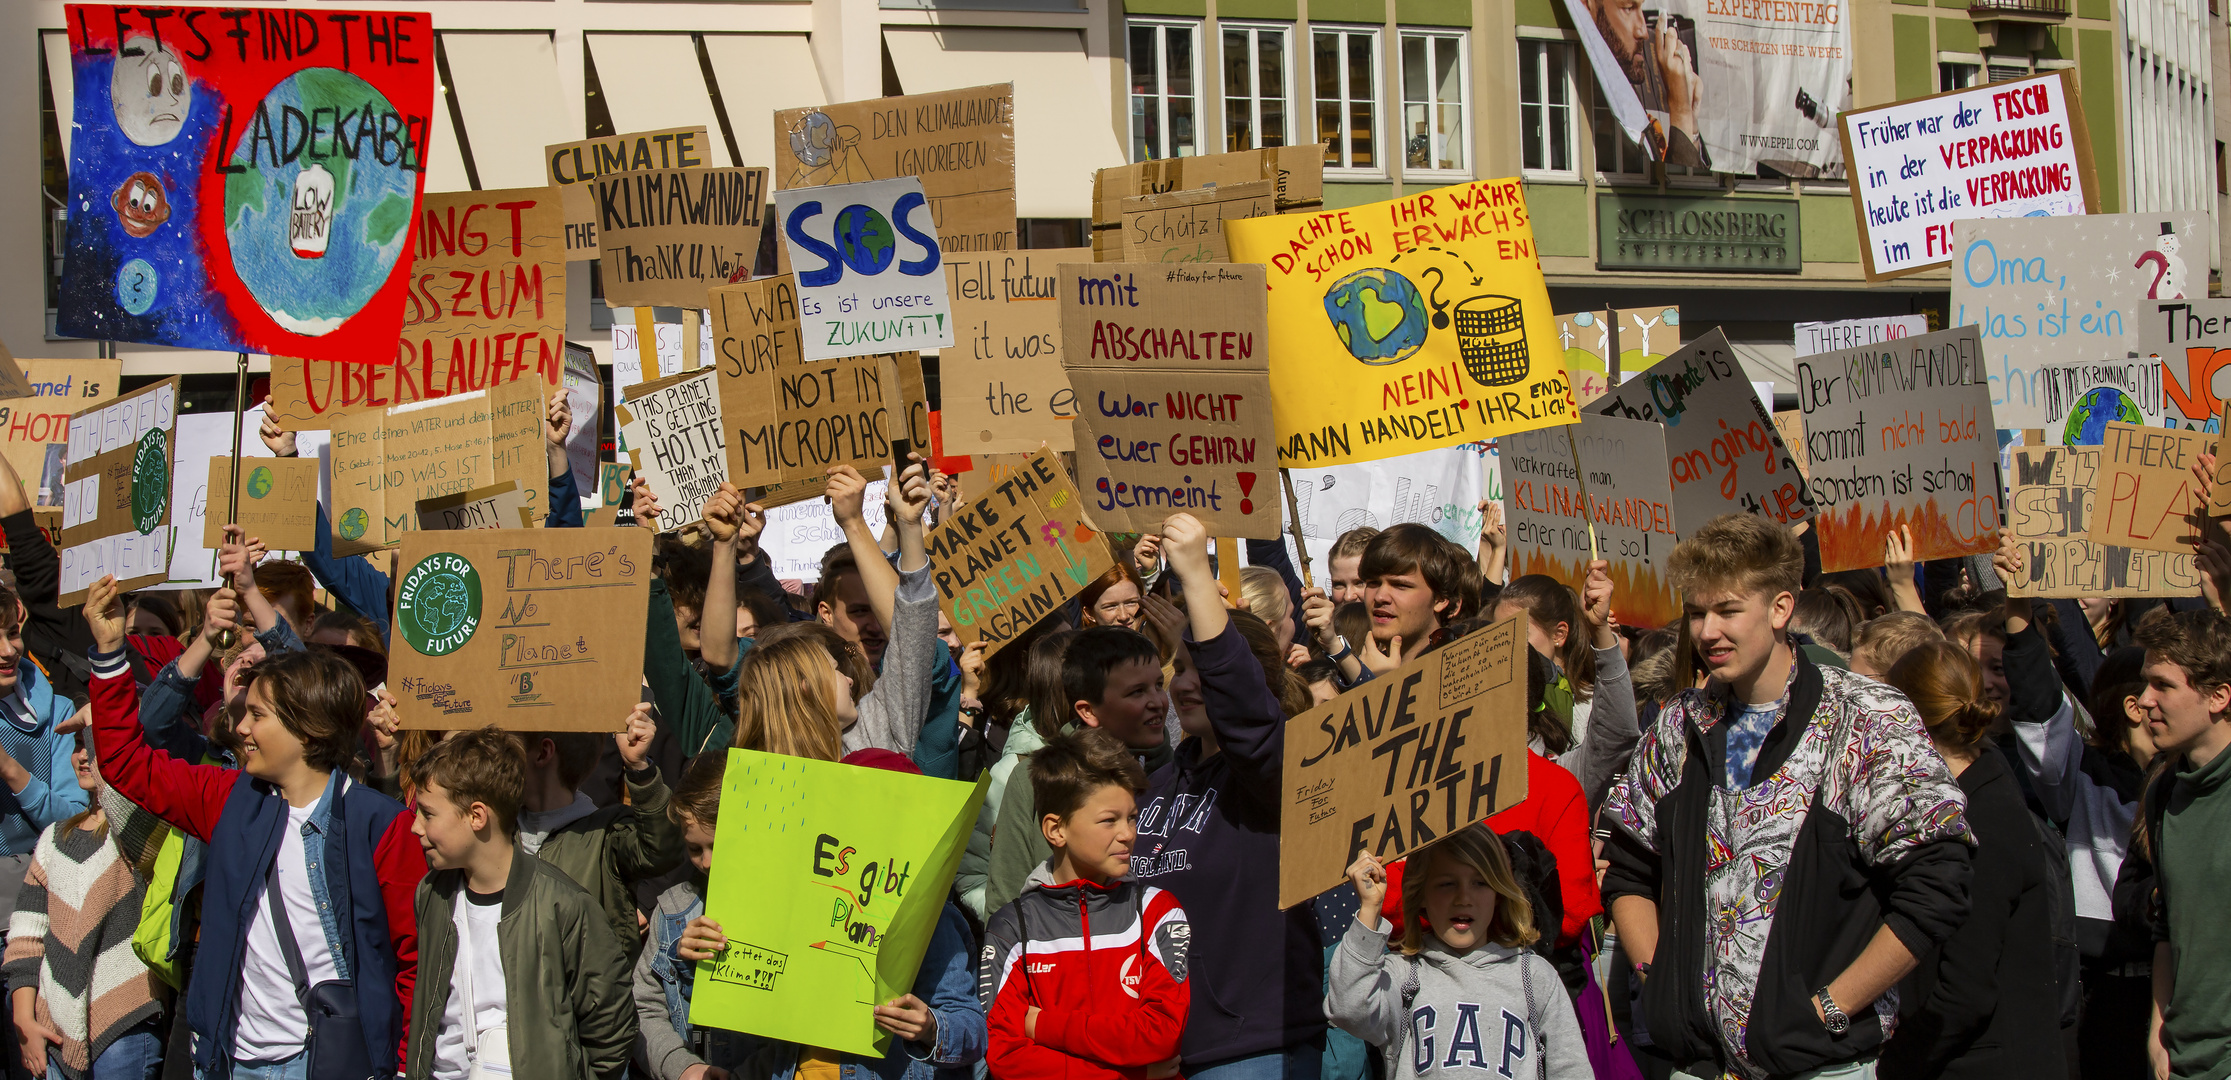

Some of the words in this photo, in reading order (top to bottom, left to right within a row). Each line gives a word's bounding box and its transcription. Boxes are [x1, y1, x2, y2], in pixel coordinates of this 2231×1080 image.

[81, 7, 212, 61] LET'S
[227, 9, 319, 65] FIND
[328, 13, 419, 72] THE
[1709, 37, 1730, 50] WIR
[1731, 39, 1779, 56] SCHÄTZEN
[1781, 43, 1805, 57] IHRE
[216, 100, 428, 175] LADEKABEL
[873, 108, 907, 140] DEN
[916, 96, 1008, 134] KLIMAWANDEL
[1858, 115, 1912, 150] Früher
[1916, 114, 1944, 137] war
[1953, 100, 1982, 130] der
[1993, 83, 2049, 122] FISCH
[551, 132, 701, 185] CLIMATE
[895, 140, 986, 177] IGNORIEREN
[1740, 134, 1820, 150] WWW.EPPLI.COM
[1868, 165, 1888, 189] in
[1900, 154, 1927, 180] der
[1939, 123, 2063, 171] VERPACKUNG
[293, 187, 333, 212] LOW
[600, 170, 762, 231] KLIMAWANDEL
[1867, 194, 1910, 228] heute
[1914, 189, 1935, 217] ist
[1938, 185, 1962, 211] die
[1965, 162, 2072, 208] VERPACKUNG
[292, 211, 330, 240] BATTERY
[786, 192, 940, 287] SOS
[1272, 211, 1355, 275] DACHTE
[1391, 194, 1437, 227] IHR
[1617, 208, 1787, 239] SCHLOSSBERG
[1306, 232, 1373, 283] SCHON
[1618, 243, 1788, 261] SWITZERLAND
[1883, 239, 1911, 264] im
[1964, 239, 2066, 291] Oma,
[449, 264, 544, 320] ZUM
[943, 260, 995, 300] Tell
[1078, 272, 1139, 307] mit
[1202, 271, 1217, 283] for
[1218, 268, 1243, 282] future
[802, 297, 822, 316] Es
[838, 293, 859, 313] ist
[872, 294, 933, 310] unsere
[2038, 298, 2071, 338] ist
[2079, 300, 2123, 337] ein
[721, 330, 786, 377] SURF
[974, 321, 993, 360] it
[1005, 334, 1055, 359] was
[1091, 319, 1252, 362] ABSCHALTEN
[82, 381, 100, 397] is
[781, 368, 837, 411] NOT
[855, 366, 881, 404] IN
[1383, 361, 1470, 411] NEIN!
[1797, 362, 1840, 414] Der
[1843, 338, 1987, 403] KLIMAWANDEL
[2042, 367, 2063, 423] OUR
[2063, 366, 2082, 406] TIME
[2082, 366, 2091, 387] IS
[2092, 365, 2136, 392] RUNNING
[2137, 363, 2161, 417] OUT
[628, 394, 664, 420] THIS
[666, 378, 711, 408] PLANET
[646, 420, 661, 438] IS
[666, 398, 717, 431] GETTING
[986, 382, 1032, 415] the
[1166, 391, 1243, 422] NICHT
[1531, 397, 1566, 419] LICH
[71, 393, 172, 456] THERE'S
[372, 426, 409, 442] deinen
[411, 416, 442, 434] VATER
[444, 416, 466, 429] und
[469, 407, 494, 426] deine
[1276, 423, 1352, 463] WANN
[1360, 402, 1466, 444] HANDELT
[1476, 391, 1530, 426] IHR
[1805, 410, 1866, 465] kommt
[1881, 410, 1925, 452] nicht
[1939, 404, 1981, 443] bald,
[412, 460, 448, 483] WAS
[456, 454, 481, 475] IST
[493, 445, 523, 470] MIT
[665, 464, 697, 486] THAN
[702, 453, 722, 474] MY
[1098, 434, 1161, 463] euer
[1169, 433, 1255, 466] GEHIRN
[2108, 426, 2193, 472] THERE
[67, 479, 96, 522] NO
[678, 470, 726, 502] IMAGINARY
[1096, 474, 1222, 512] gemeint
[1590, 470, 1616, 489] man,
[1813, 464, 1885, 507] sondern
[1892, 463, 1913, 495] ist
[1923, 457, 1974, 494] schon
[443, 499, 499, 530] DON'T
[924, 498, 999, 571] MAKE
[996, 457, 1055, 507] THE
[1514, 478, 1677, 535] KLIMAWANDEL
[1518, 518, 1555, 546] eher
[497, 545, 637, 588] There's
[936, 514, 1032, 600] PLANET
[400, 557, 441, 610] FRIDAYS
[444, 557, 470, 578] FOR
[953, 552, 1042, 626] GREEN
[500, 594, 538, 625] No
[426, 615, 477, 653] FUTURE
[500, 634, 588, 667] Planet
[1300, 669, 1423, 768] SAVE
[1372, 705, 1473, 797] THE
[1296, 777, 1336, 800] Friday
[1309, 806, 1337, 822] Future
[1341, 753, 1503, 879] EARTH
[813, 833, 856, 878] Es
[859, 857, 910, 907] gibt
[767, 954, 783, 968] das
[1412, 1001, 1528, 1080] GAP
